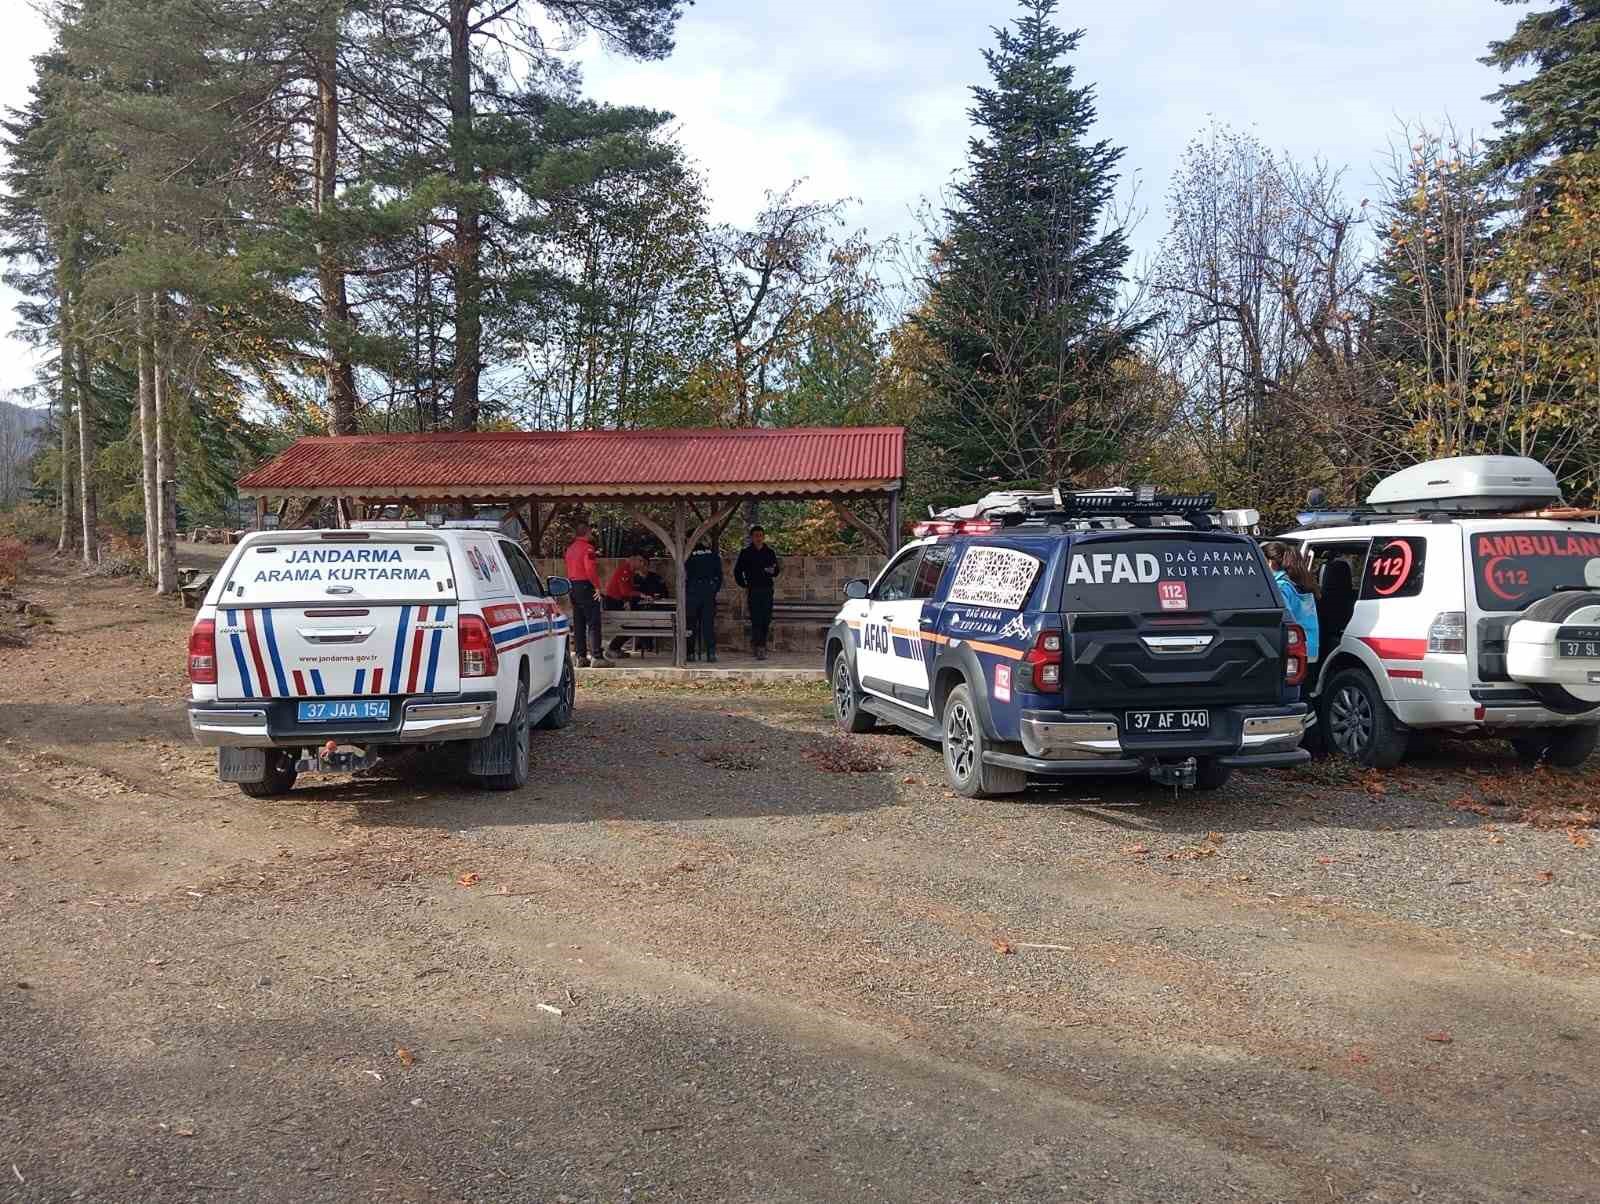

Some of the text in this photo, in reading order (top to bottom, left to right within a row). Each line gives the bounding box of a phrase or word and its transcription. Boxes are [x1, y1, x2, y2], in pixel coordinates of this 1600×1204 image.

[285, 550, 403, 564] JANDARMA
[1164, 550, 1256, 563] DAĞ ARAMA
[1067, 553, 1160, 584] AFAD
[1166, 566, 1257, 577] KURTARMA
[1373, 558, 1403, 576] 112
[254, 568, 431, 582] ARAMA KURTARMA
[1494, 570, 1529, 585] 112
[1162, 585, 1183, 599] 112
[965, 608, 1002, 620] DAĞ ARAMA
[960, 620, 998, 633] KURTARMA
[864, 623, 889, 655] AFAD
[1567, 643, 1579, 656] 37
[299, 655, 379, 663] www.jandarma.gov.tr
[307, 702, 387, 717] 37 JAA 154
[1134, 712, 1206, 729] 37 AF 040
